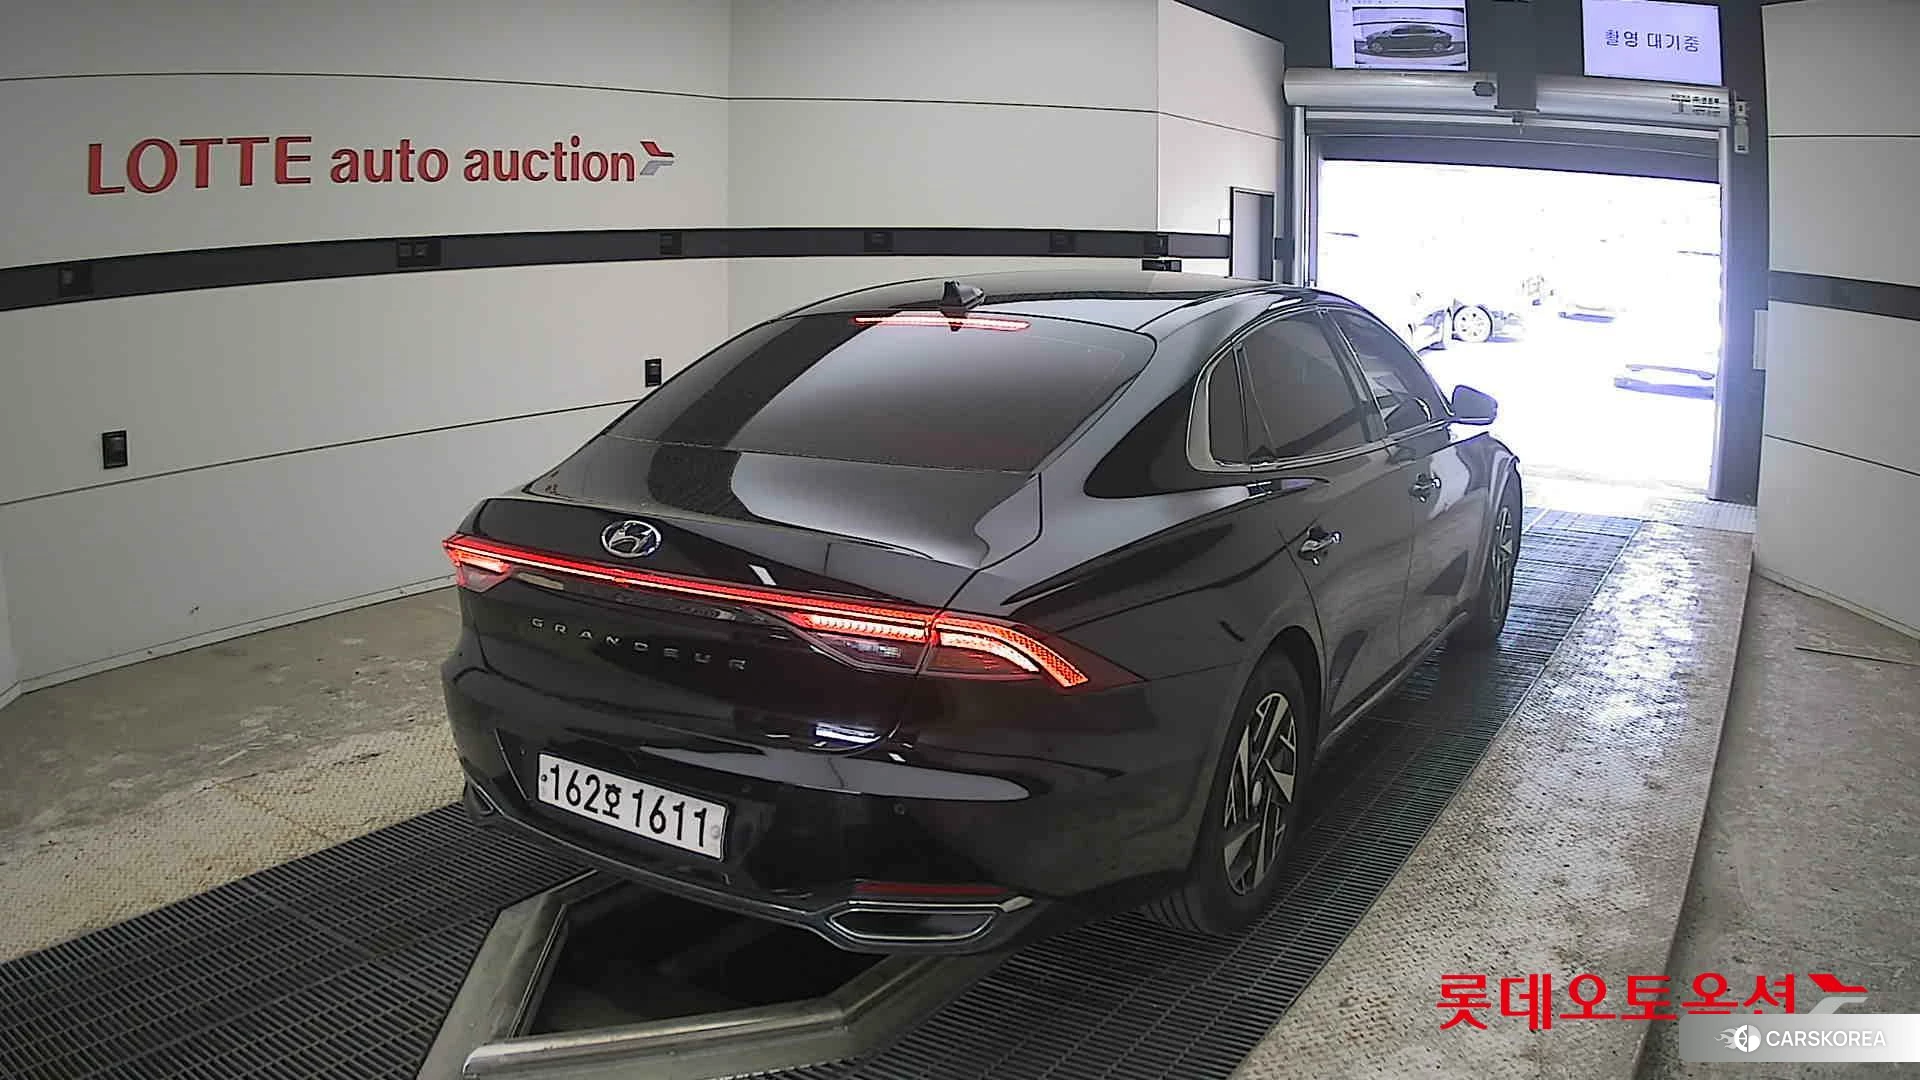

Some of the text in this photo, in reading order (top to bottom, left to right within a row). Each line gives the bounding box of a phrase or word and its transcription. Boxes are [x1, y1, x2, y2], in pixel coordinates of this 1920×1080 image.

[1647, 32, 1700, 53] 대기중
[88, 135, 635, 195] LOTTE auto auction
[530, 616, 747, 672] GRANDEUR
[550, 763, 708, 848] 162호 1611
